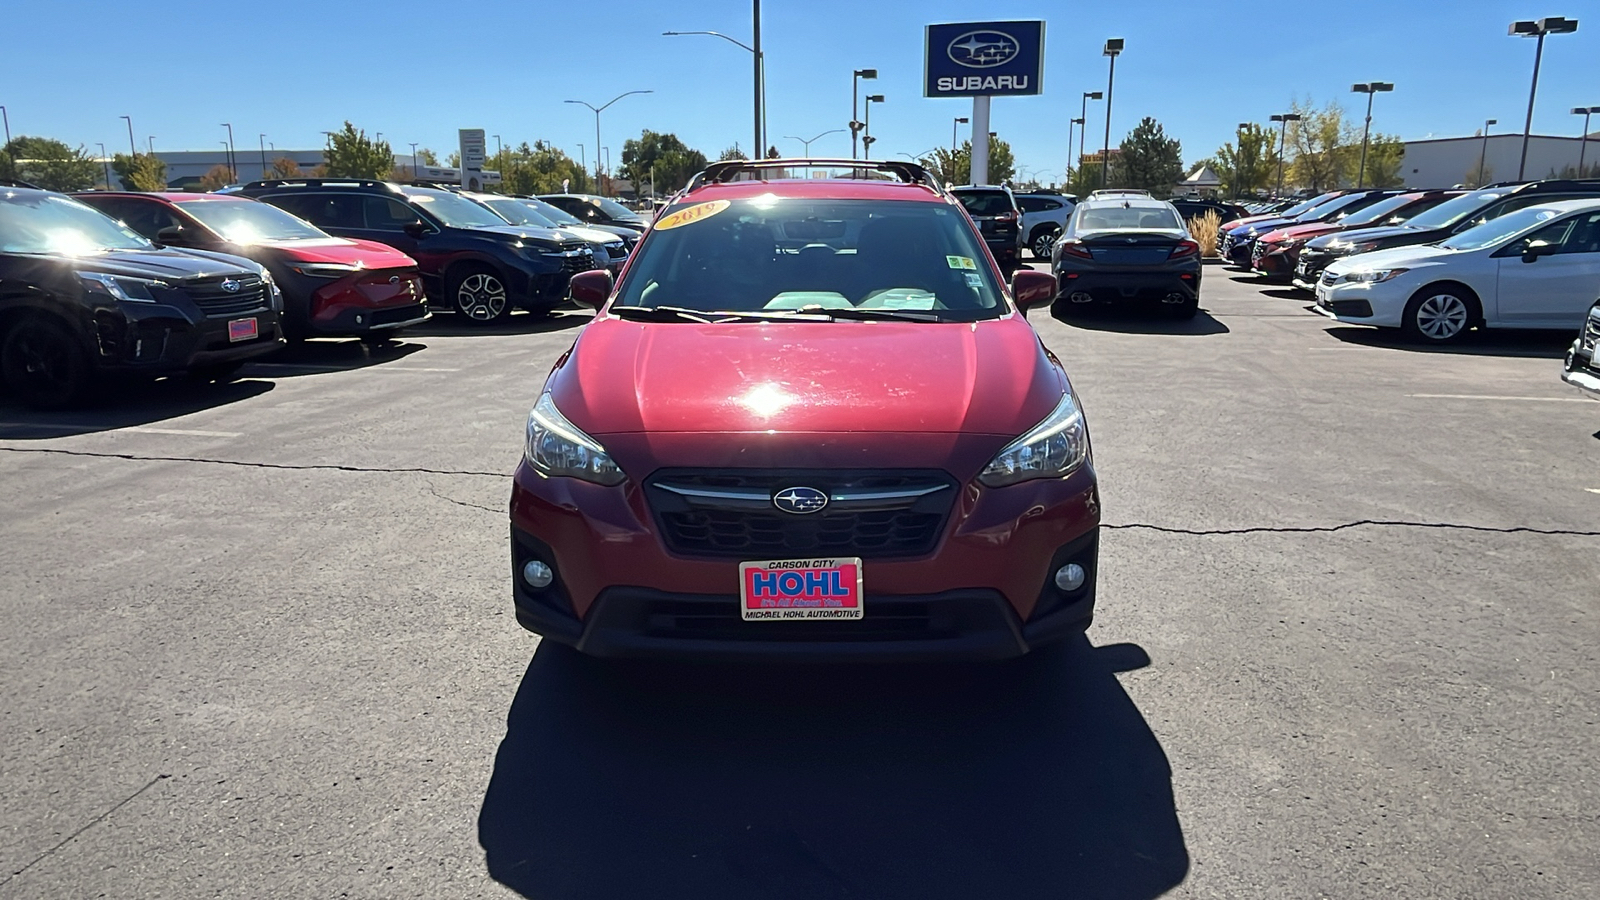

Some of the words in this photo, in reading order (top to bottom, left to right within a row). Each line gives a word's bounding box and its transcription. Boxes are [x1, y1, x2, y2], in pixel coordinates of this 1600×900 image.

[937, 75, 1028, 91] SUBARU
[671, 203, 716, 226] 2019
[768, 560, 810, 569] CARSON
[812, 559, 835, 568] CITY
[753, 571, 849, 597] HOHL
[792, 598, 821, 607] About
[745, 611, 781, 619] MICHAEL
[783, 610, 805, 618] HOHL
[807, 610, 861, 618] AUTOMOTIVE
